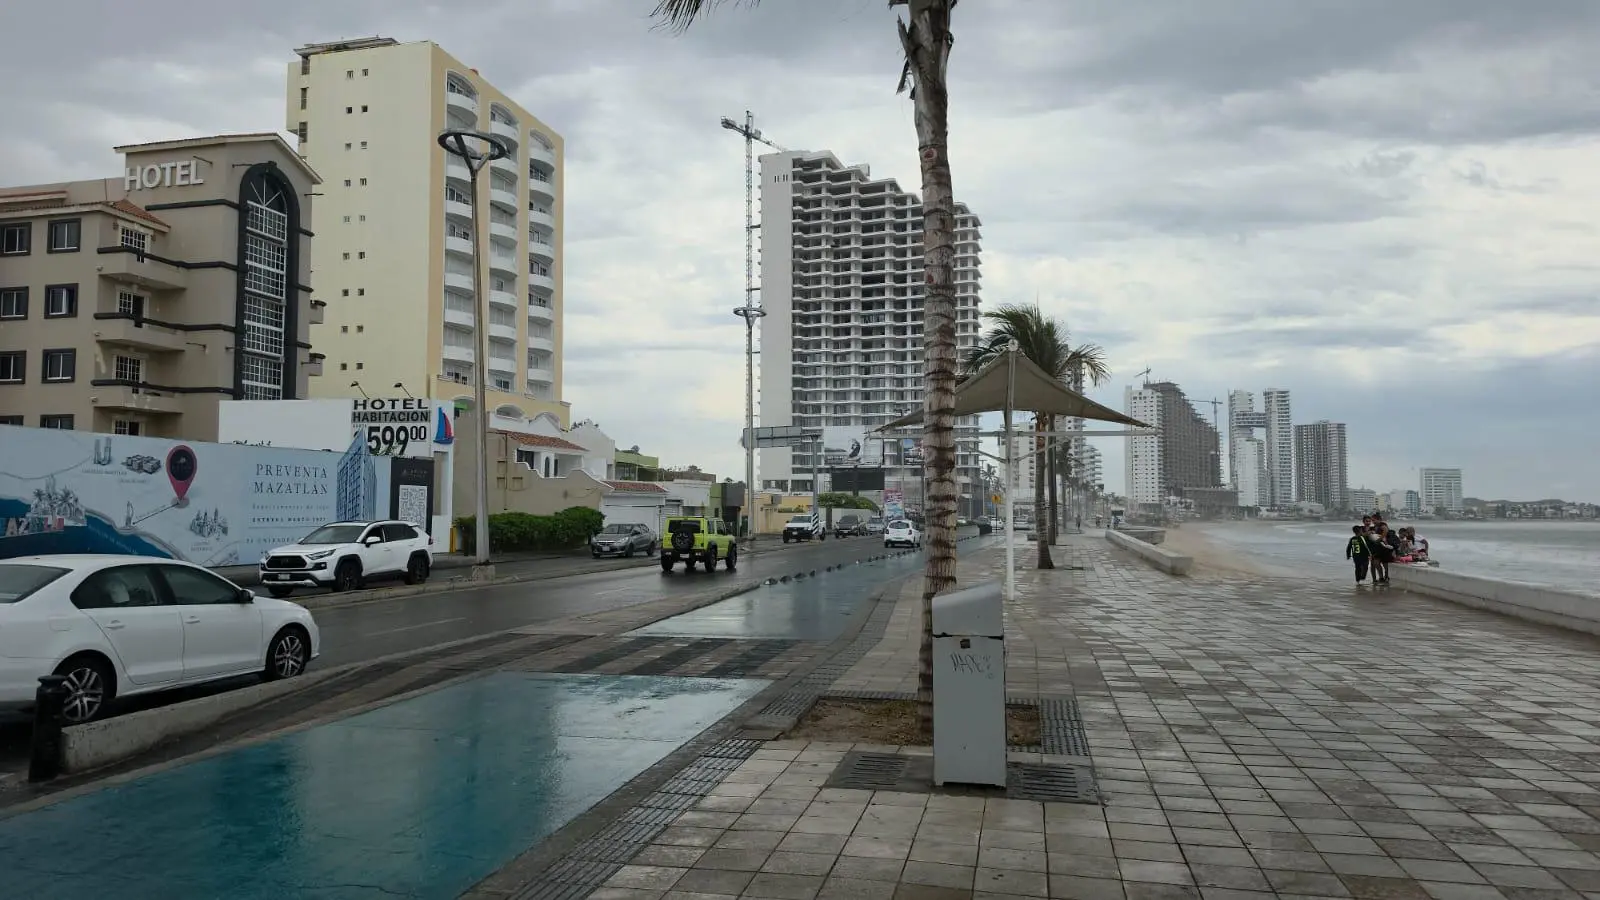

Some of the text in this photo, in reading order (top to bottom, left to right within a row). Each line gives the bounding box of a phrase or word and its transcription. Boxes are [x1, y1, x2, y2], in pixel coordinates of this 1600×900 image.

[124, 160, 204, 190] HOTEL
[353, 398, 428, 410] HOTEL
[352, 411, 428, 422] HABITACION
[256, 463, 327, 479] PREVENTA
